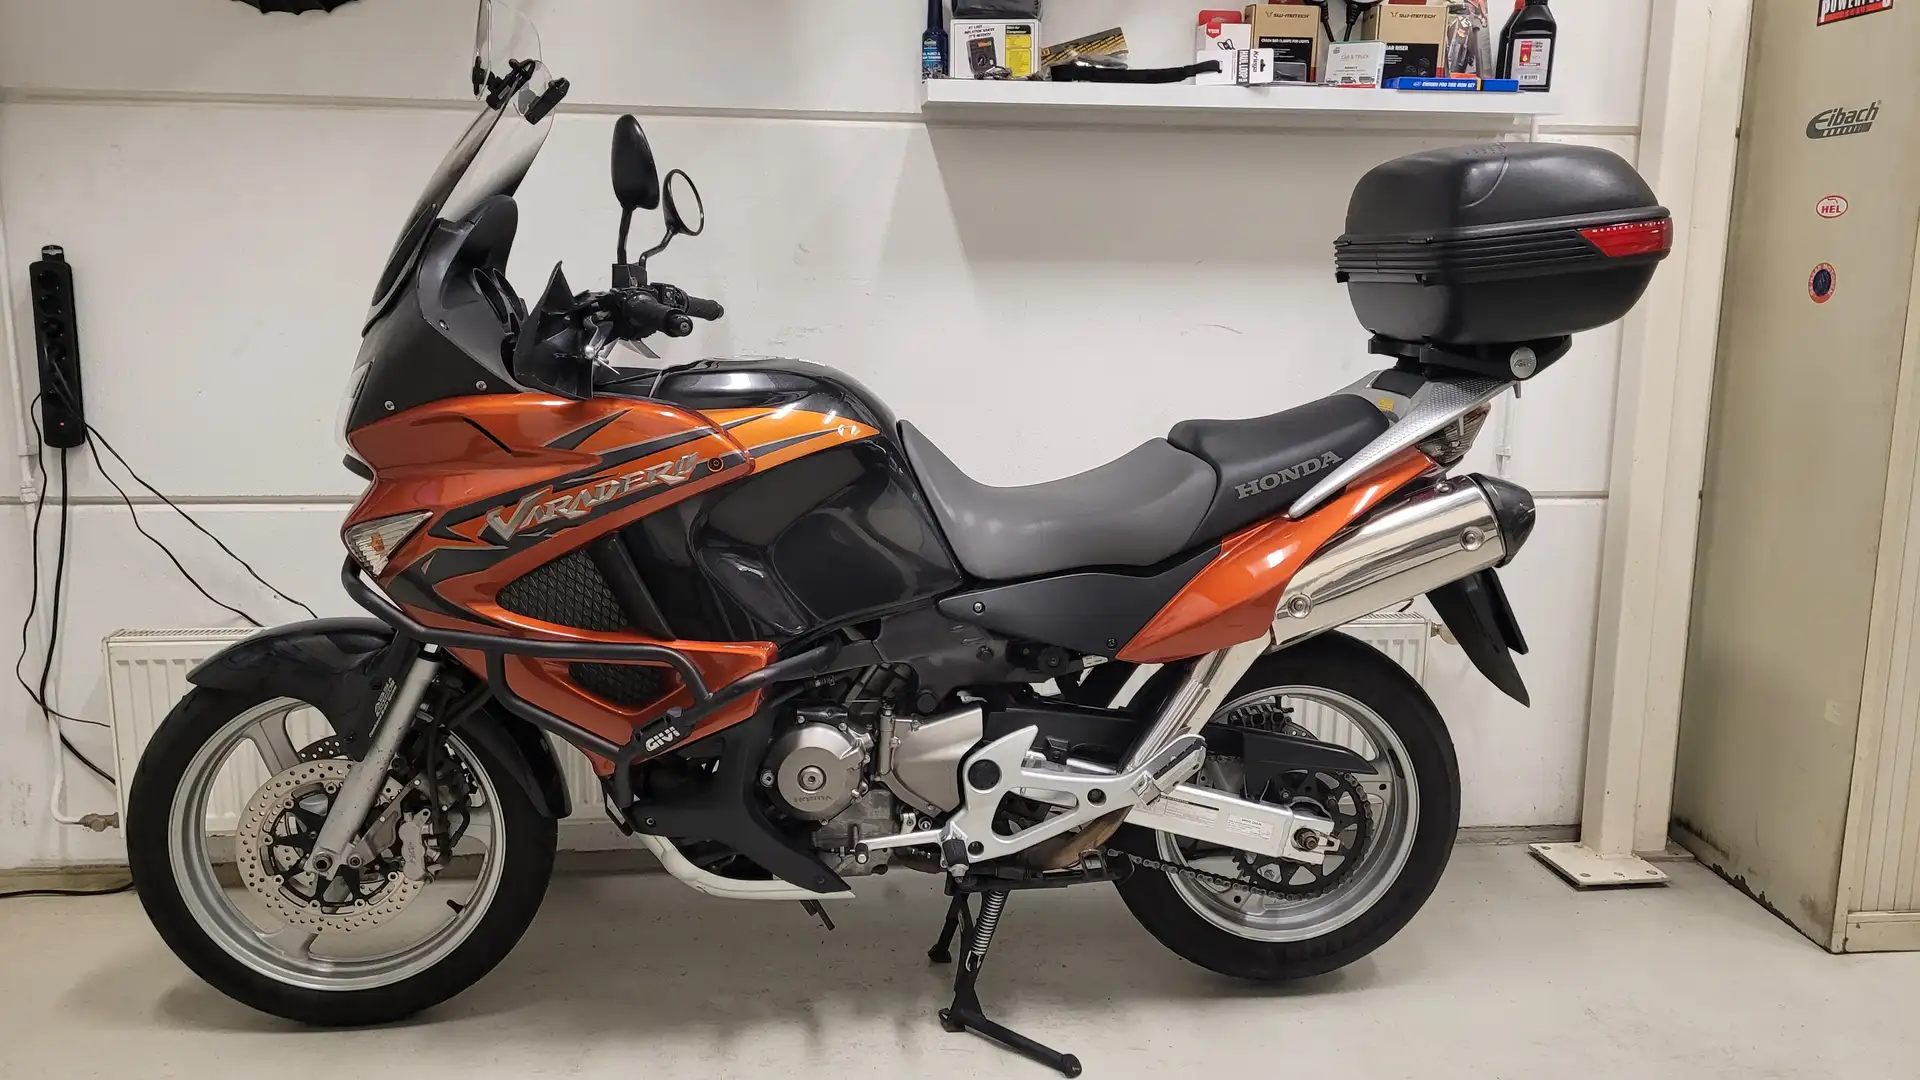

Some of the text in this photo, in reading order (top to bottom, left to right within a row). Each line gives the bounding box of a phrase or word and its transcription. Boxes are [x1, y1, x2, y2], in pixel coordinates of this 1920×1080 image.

[1252, 50, 1260, 72] Kriega
[1806, 101, 1879, 138] Eibach
[1821, 205, 1841, 213] HEL
[1235, 450, 1343, 500] HONDA
[486, 452, 699, 541] VARADERO
[645, 725, 680, 751] GIVI
